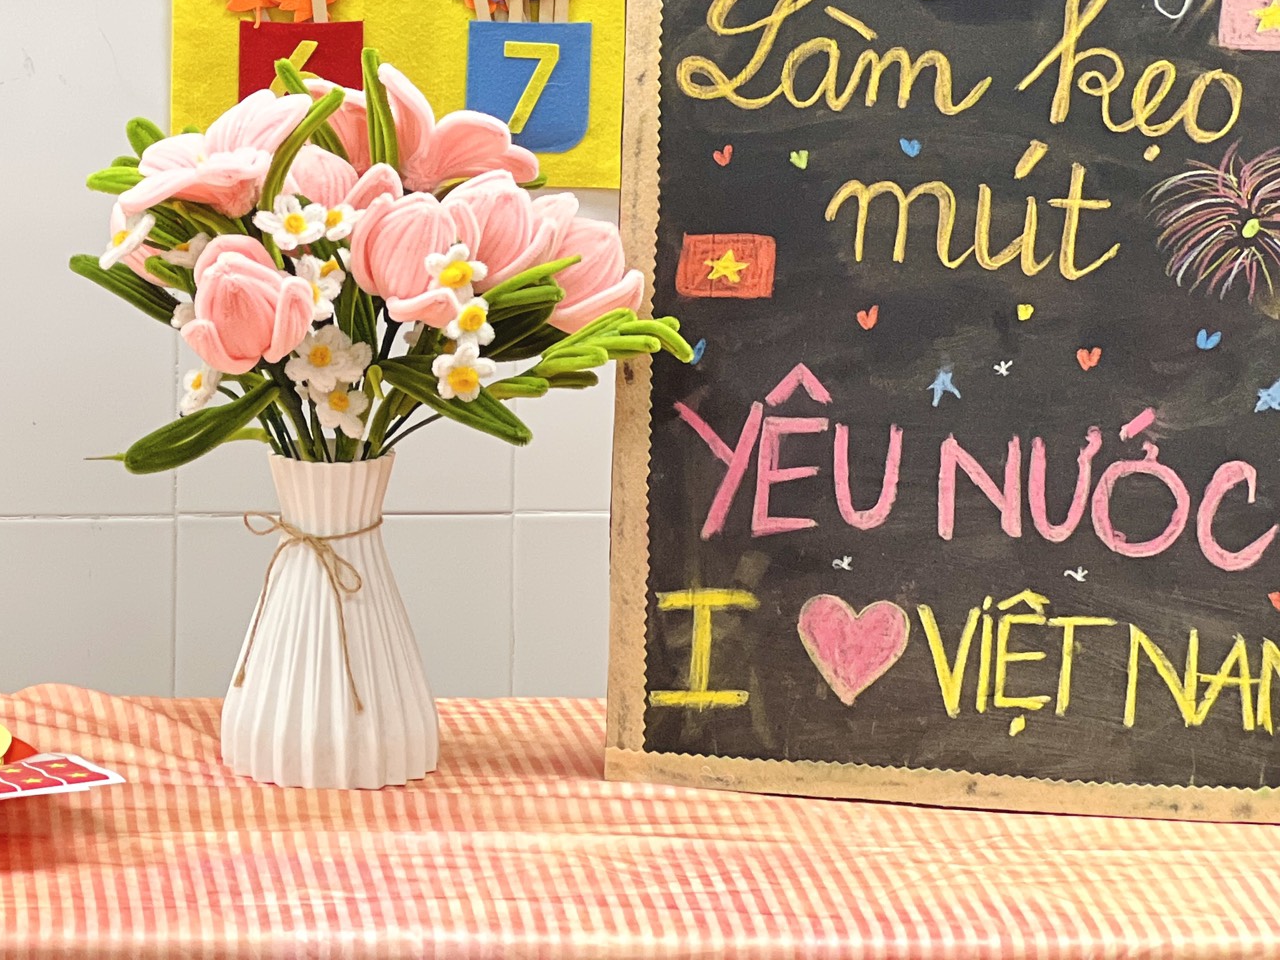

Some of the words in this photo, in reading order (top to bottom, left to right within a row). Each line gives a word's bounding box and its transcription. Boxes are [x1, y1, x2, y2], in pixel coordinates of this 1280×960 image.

[504, 41, 560, 134] 7
[825, 141, 1120, 282] mút
[673, 362, 903, 539] YÊU
[938, 407, 1279, 571] NƯỚC
[650, 588, 760, 712] I
